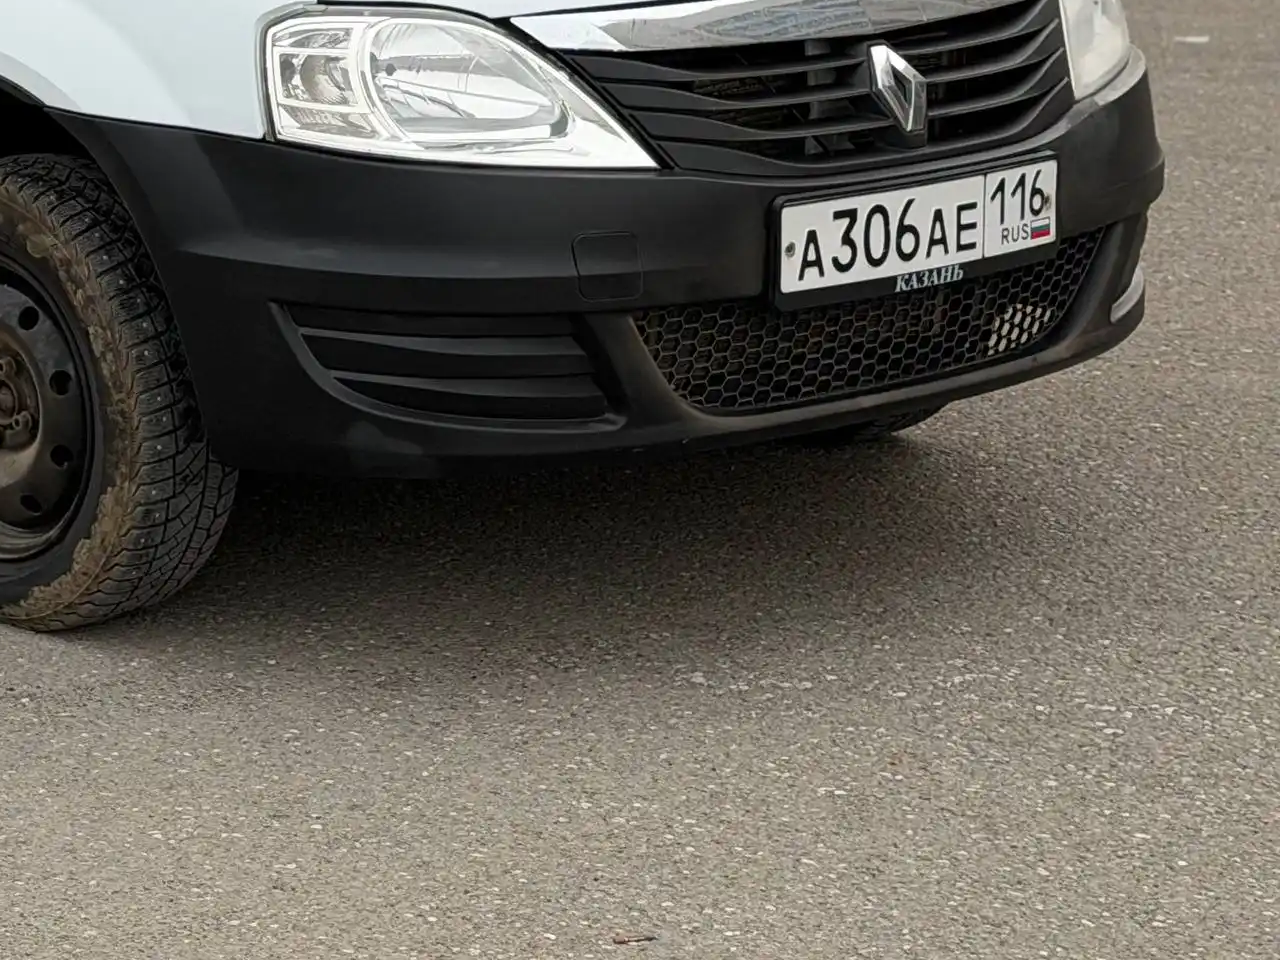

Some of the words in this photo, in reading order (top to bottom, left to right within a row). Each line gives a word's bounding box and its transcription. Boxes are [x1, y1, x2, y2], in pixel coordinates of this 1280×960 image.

[990, 169, 1045, 226] 116
[1001, 223, 1030, 245] RUS
[894, 264, 964, 293] КАЗАНЬ
